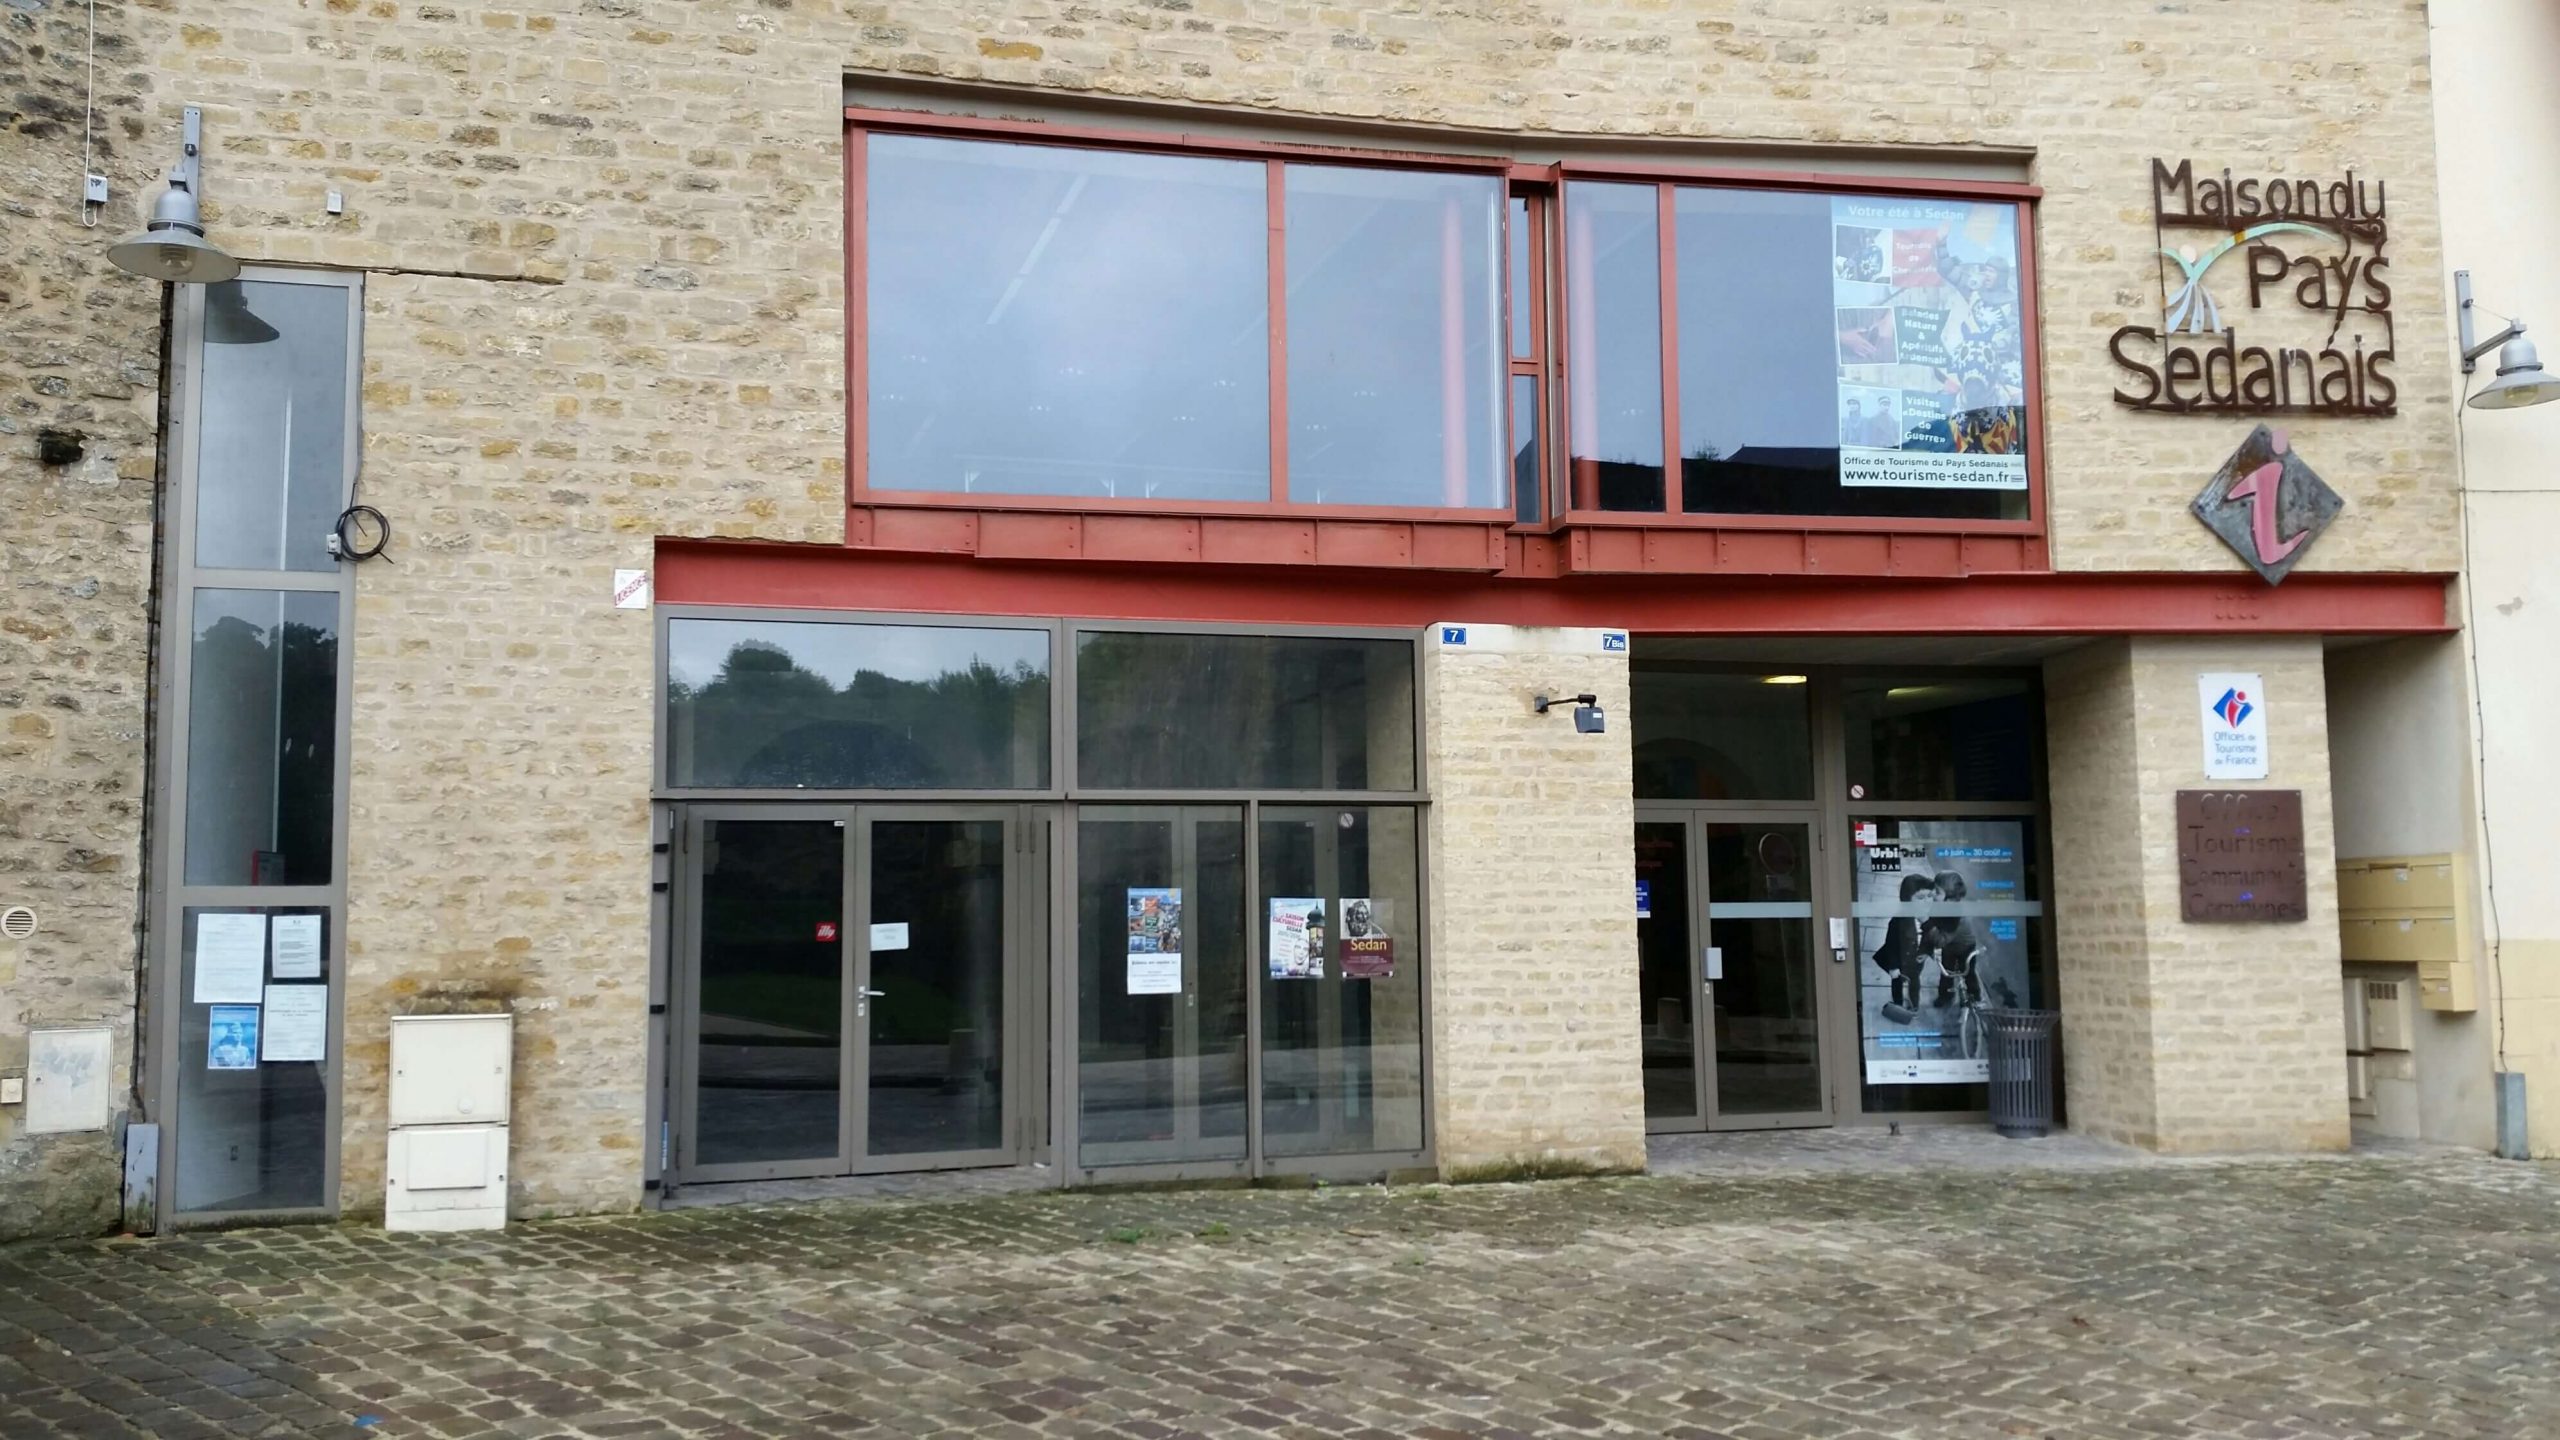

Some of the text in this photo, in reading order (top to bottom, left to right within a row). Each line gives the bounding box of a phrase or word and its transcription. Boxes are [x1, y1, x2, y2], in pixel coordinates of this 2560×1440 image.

[1848, 205, 1884, 217] Votre
[1888, 205, 1910, 218] été
[1925, 207, 1964, 220] Sedan
[2248, 245, 2392, 322] Pays
[1904, 319, 1937, 331] Nature
[2108, 325, 2398, 406] Sedanais
[1905, 396, 1941, 408] Visites
[1918, 421, 1932, 430] de
[1844, 456, 1871, 466] Office
[1874, 457, 1886, 466] de
[1888, 457, 1929, 467] Tourisme
[1932, 458, 1944, 467] du
[1946, 459, 1967, 469] Pays
[1969, 459, 2009, 469] Sedanais
[1844, 469, 2010, 483] www.tourisme-sedan.fr
[1450, 630, 1459, 642] 7
[2214, 731, 2246, 743] Offices
[2215, 743, 2257, 754] Tourisme
[2225, 755, 2257, 766] France
[1870, 847, 1898, 858] Urbi
[1871, 863, 1901, 871] SEDAN
[817, 925, 836, 939] illy
[1351, 937, 1387, 951] Sedan
